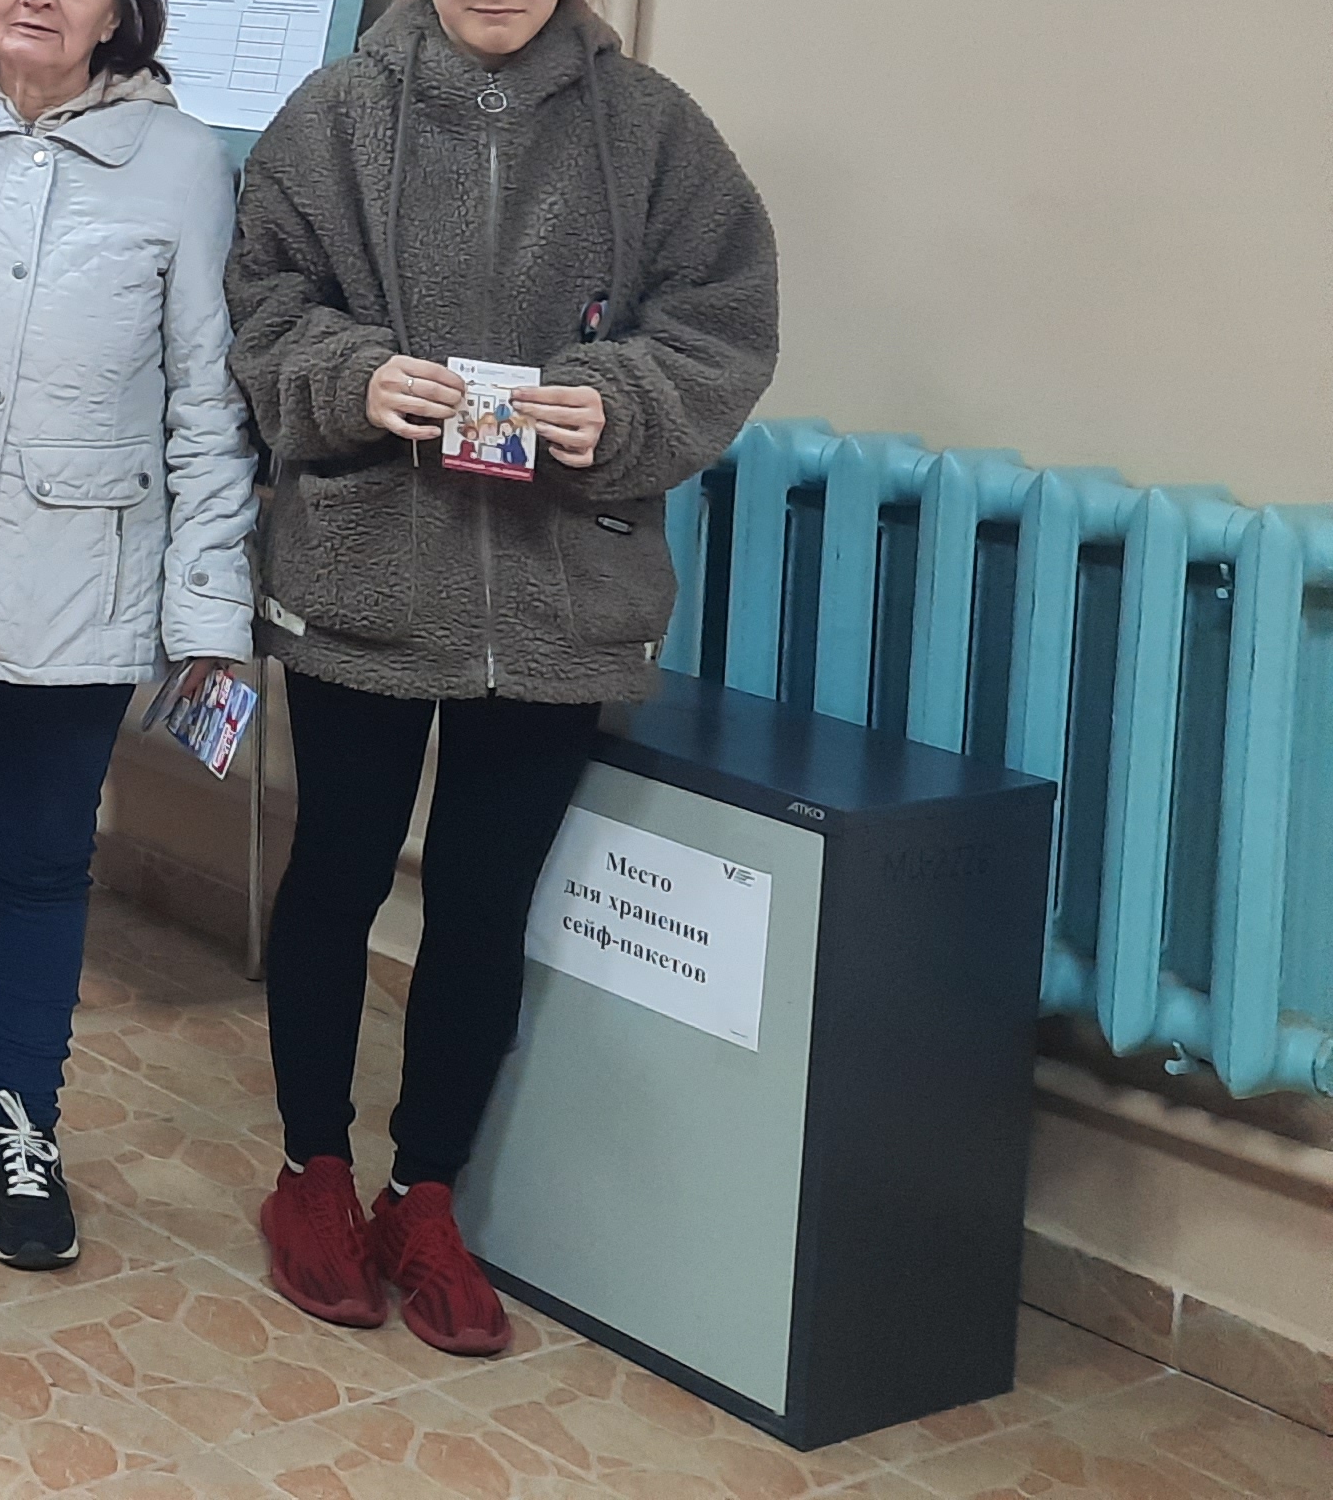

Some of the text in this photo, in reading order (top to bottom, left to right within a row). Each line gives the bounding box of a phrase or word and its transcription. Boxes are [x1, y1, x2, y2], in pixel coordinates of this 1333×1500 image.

[606, 852, 672, 892] Место
[564, 879, 710, 946] для хранения
[563, 915, 706, 984] сейф-пакетов
